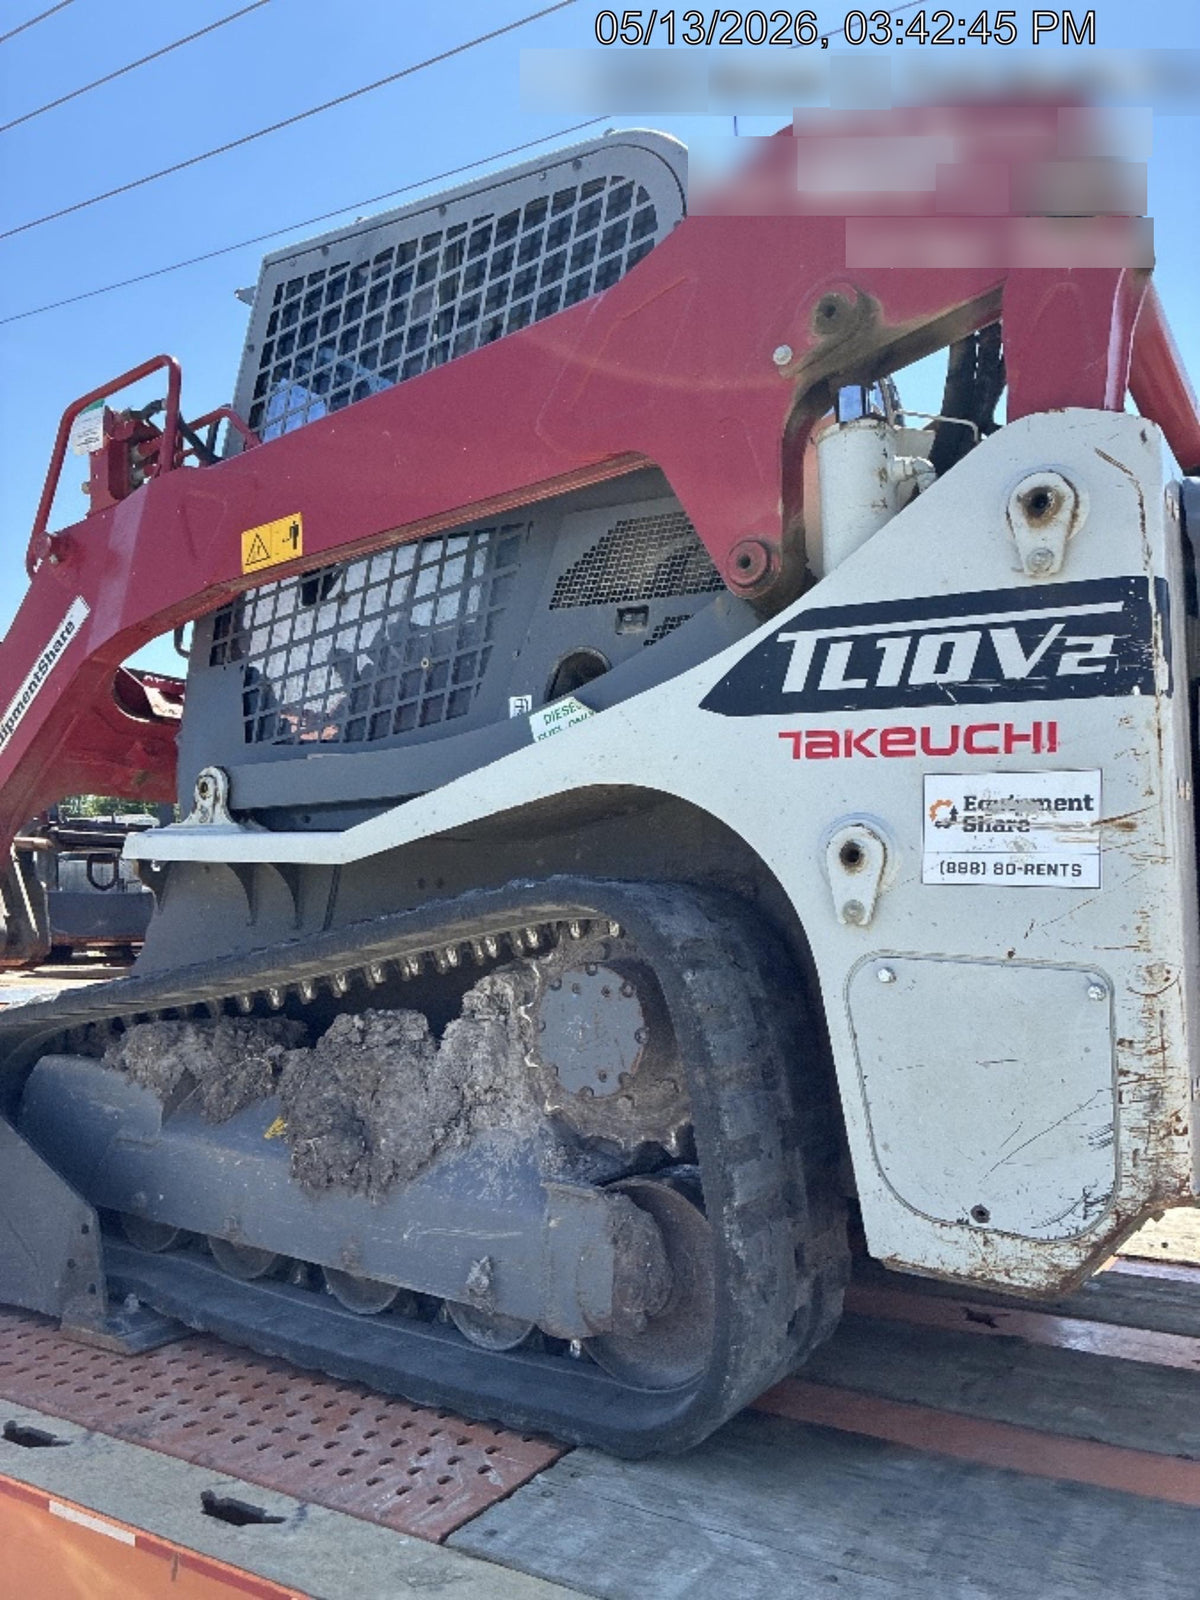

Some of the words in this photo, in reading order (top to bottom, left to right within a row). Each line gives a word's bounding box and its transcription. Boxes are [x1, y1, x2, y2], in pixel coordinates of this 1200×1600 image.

[778, 721, 1059, 760] TAKEUCHI
[939, 860, 986, 876] (888)
[993, 862, 1082, 878] 80-RENTS
